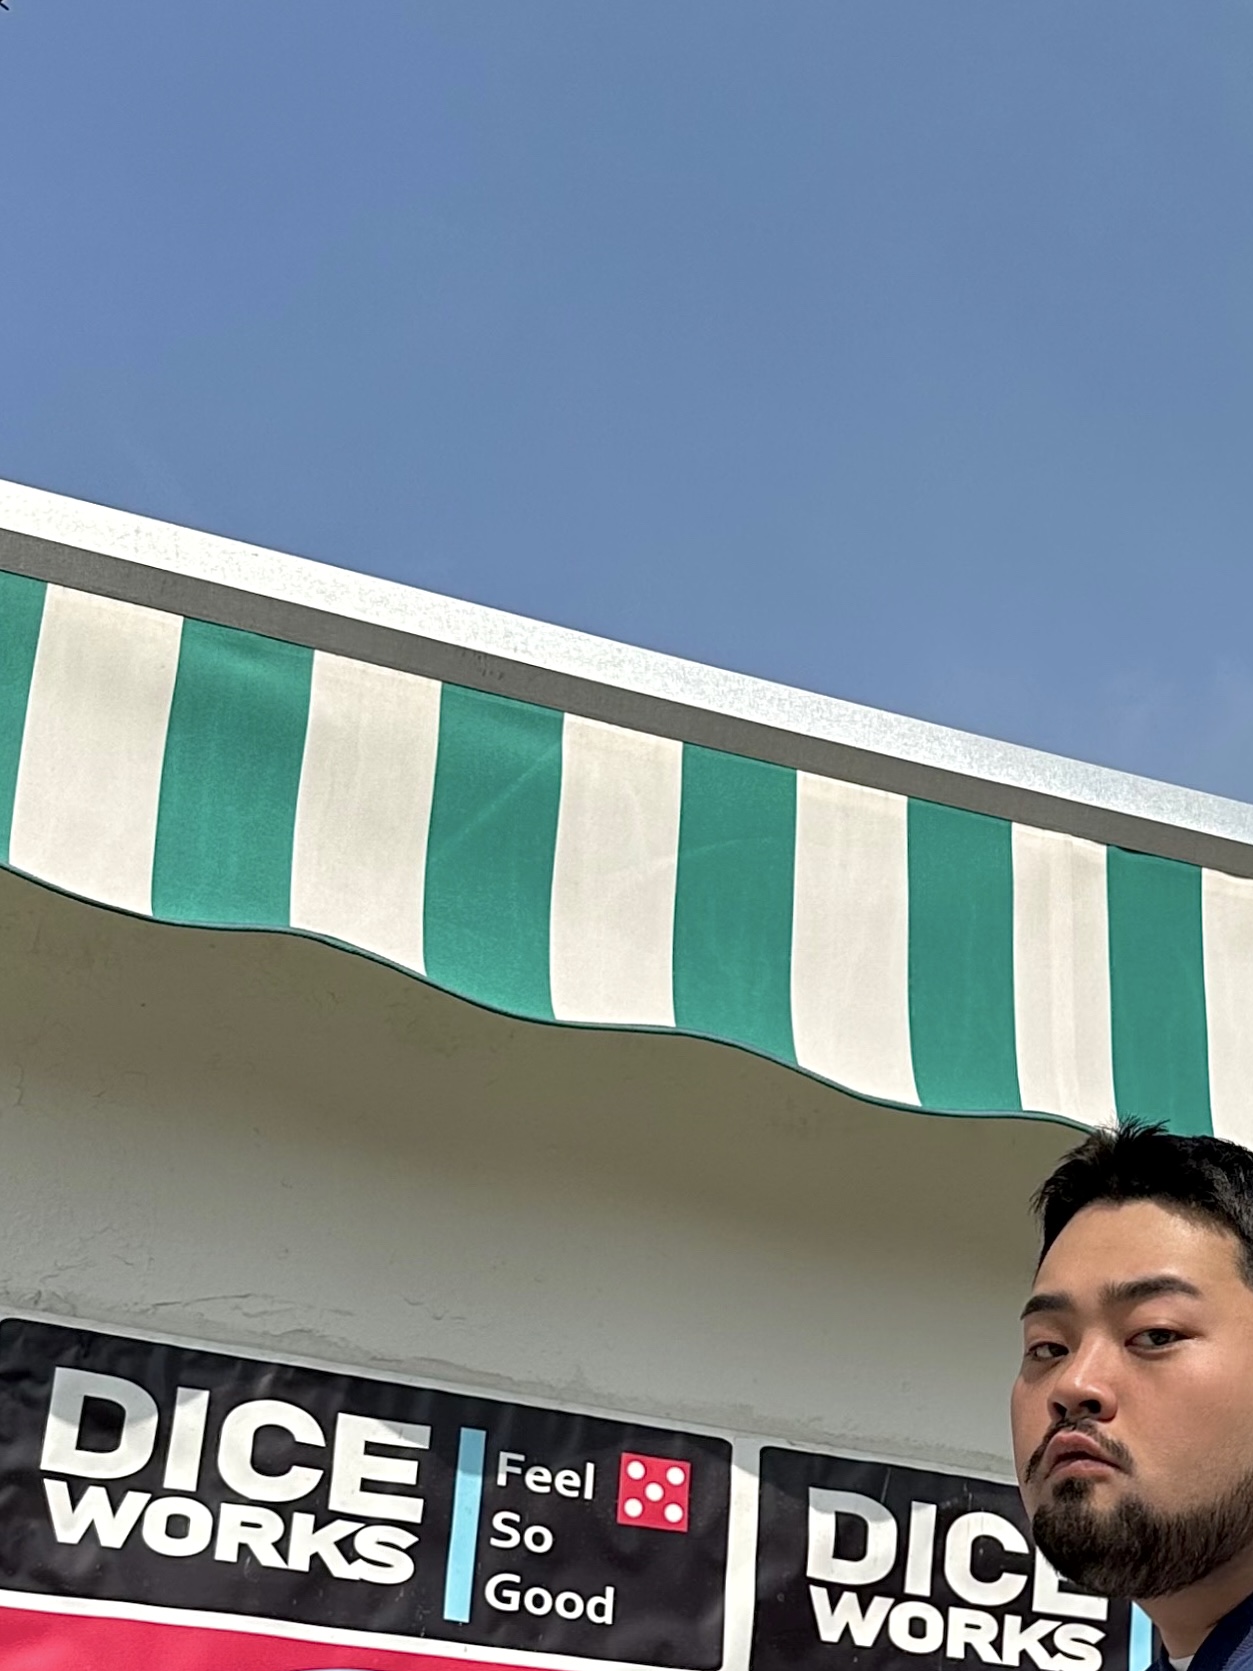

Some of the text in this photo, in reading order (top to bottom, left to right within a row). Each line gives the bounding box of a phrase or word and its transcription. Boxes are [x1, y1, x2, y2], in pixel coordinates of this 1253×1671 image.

[39, 1366, 432, 1524] DICE
[496, 1450, 596, 1501] Feel
[42, 1477, 420, 1585] WORKS
[489, 1510, 554, 1554] So
[483, 1572, 616, 1626] Good
